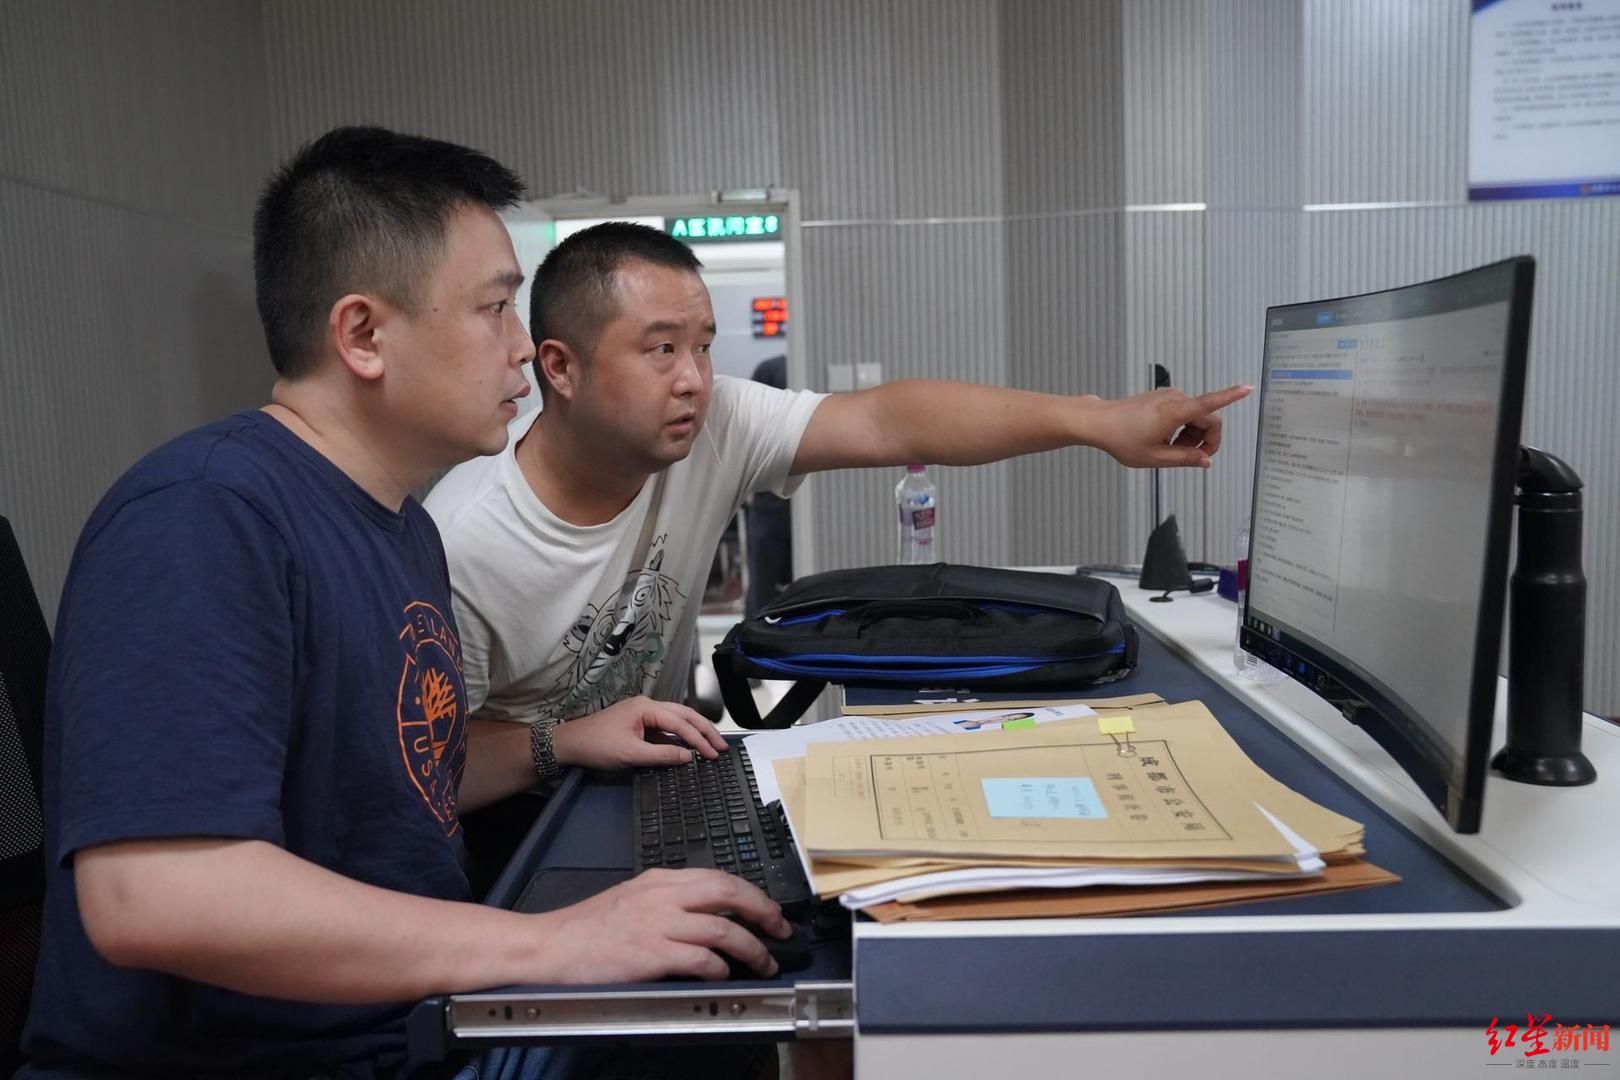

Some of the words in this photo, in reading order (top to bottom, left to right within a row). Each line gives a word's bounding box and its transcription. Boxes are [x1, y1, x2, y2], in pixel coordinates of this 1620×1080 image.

[1139, 756, 1206, 831] 成都市公安局
